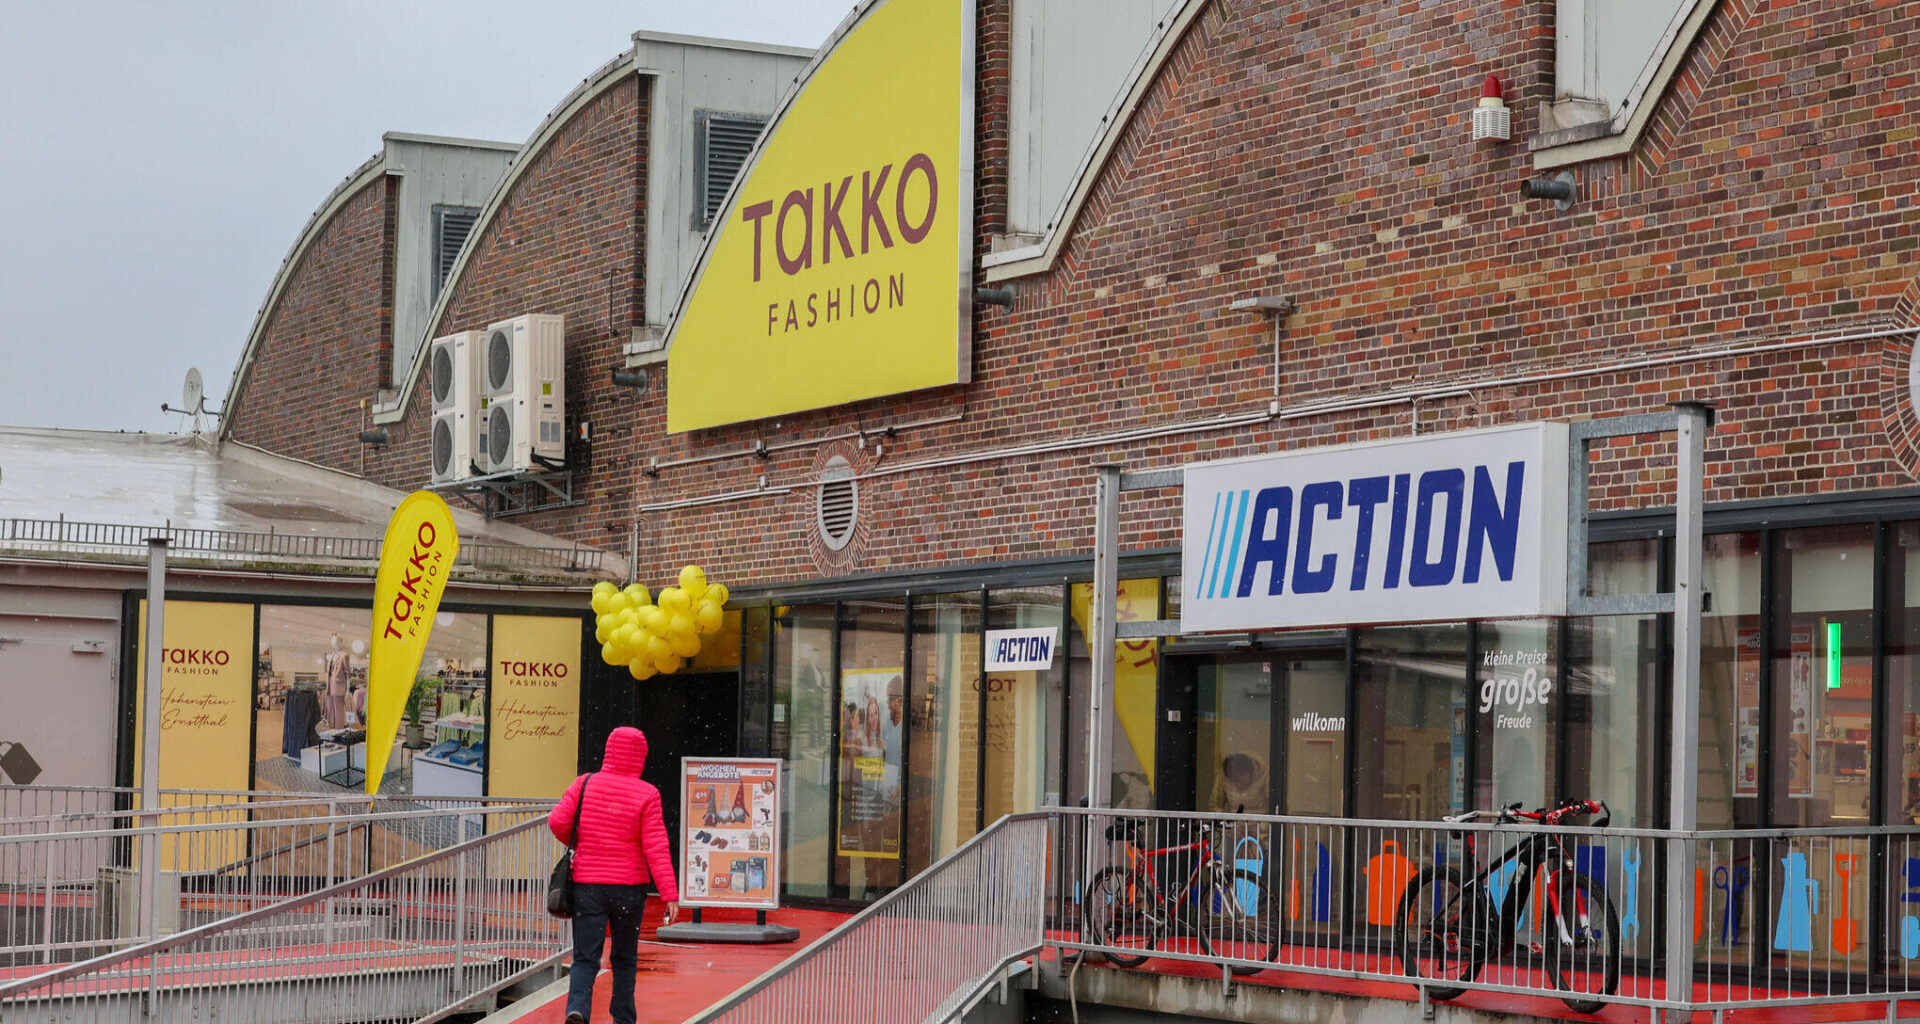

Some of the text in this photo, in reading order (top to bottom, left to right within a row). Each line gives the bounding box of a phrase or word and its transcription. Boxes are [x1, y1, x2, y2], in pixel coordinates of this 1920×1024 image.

[768, 272, 904, 336] FASHION
[1236, 461, 1525, 598] ACTION
[409, 551, 442, 637] FASHION
[996, 636, 1050, 663] ACTION
[1483, 648, 1547, 666] kleine Preise
[167, 667, 219, 675] FASHION
[509, 679, 558, 688] FASHION
[1479, 667, 1552, 713] große
[1497, 712, 1532, 729] Freude
[701, 764, 736, 772] WOCHEN
